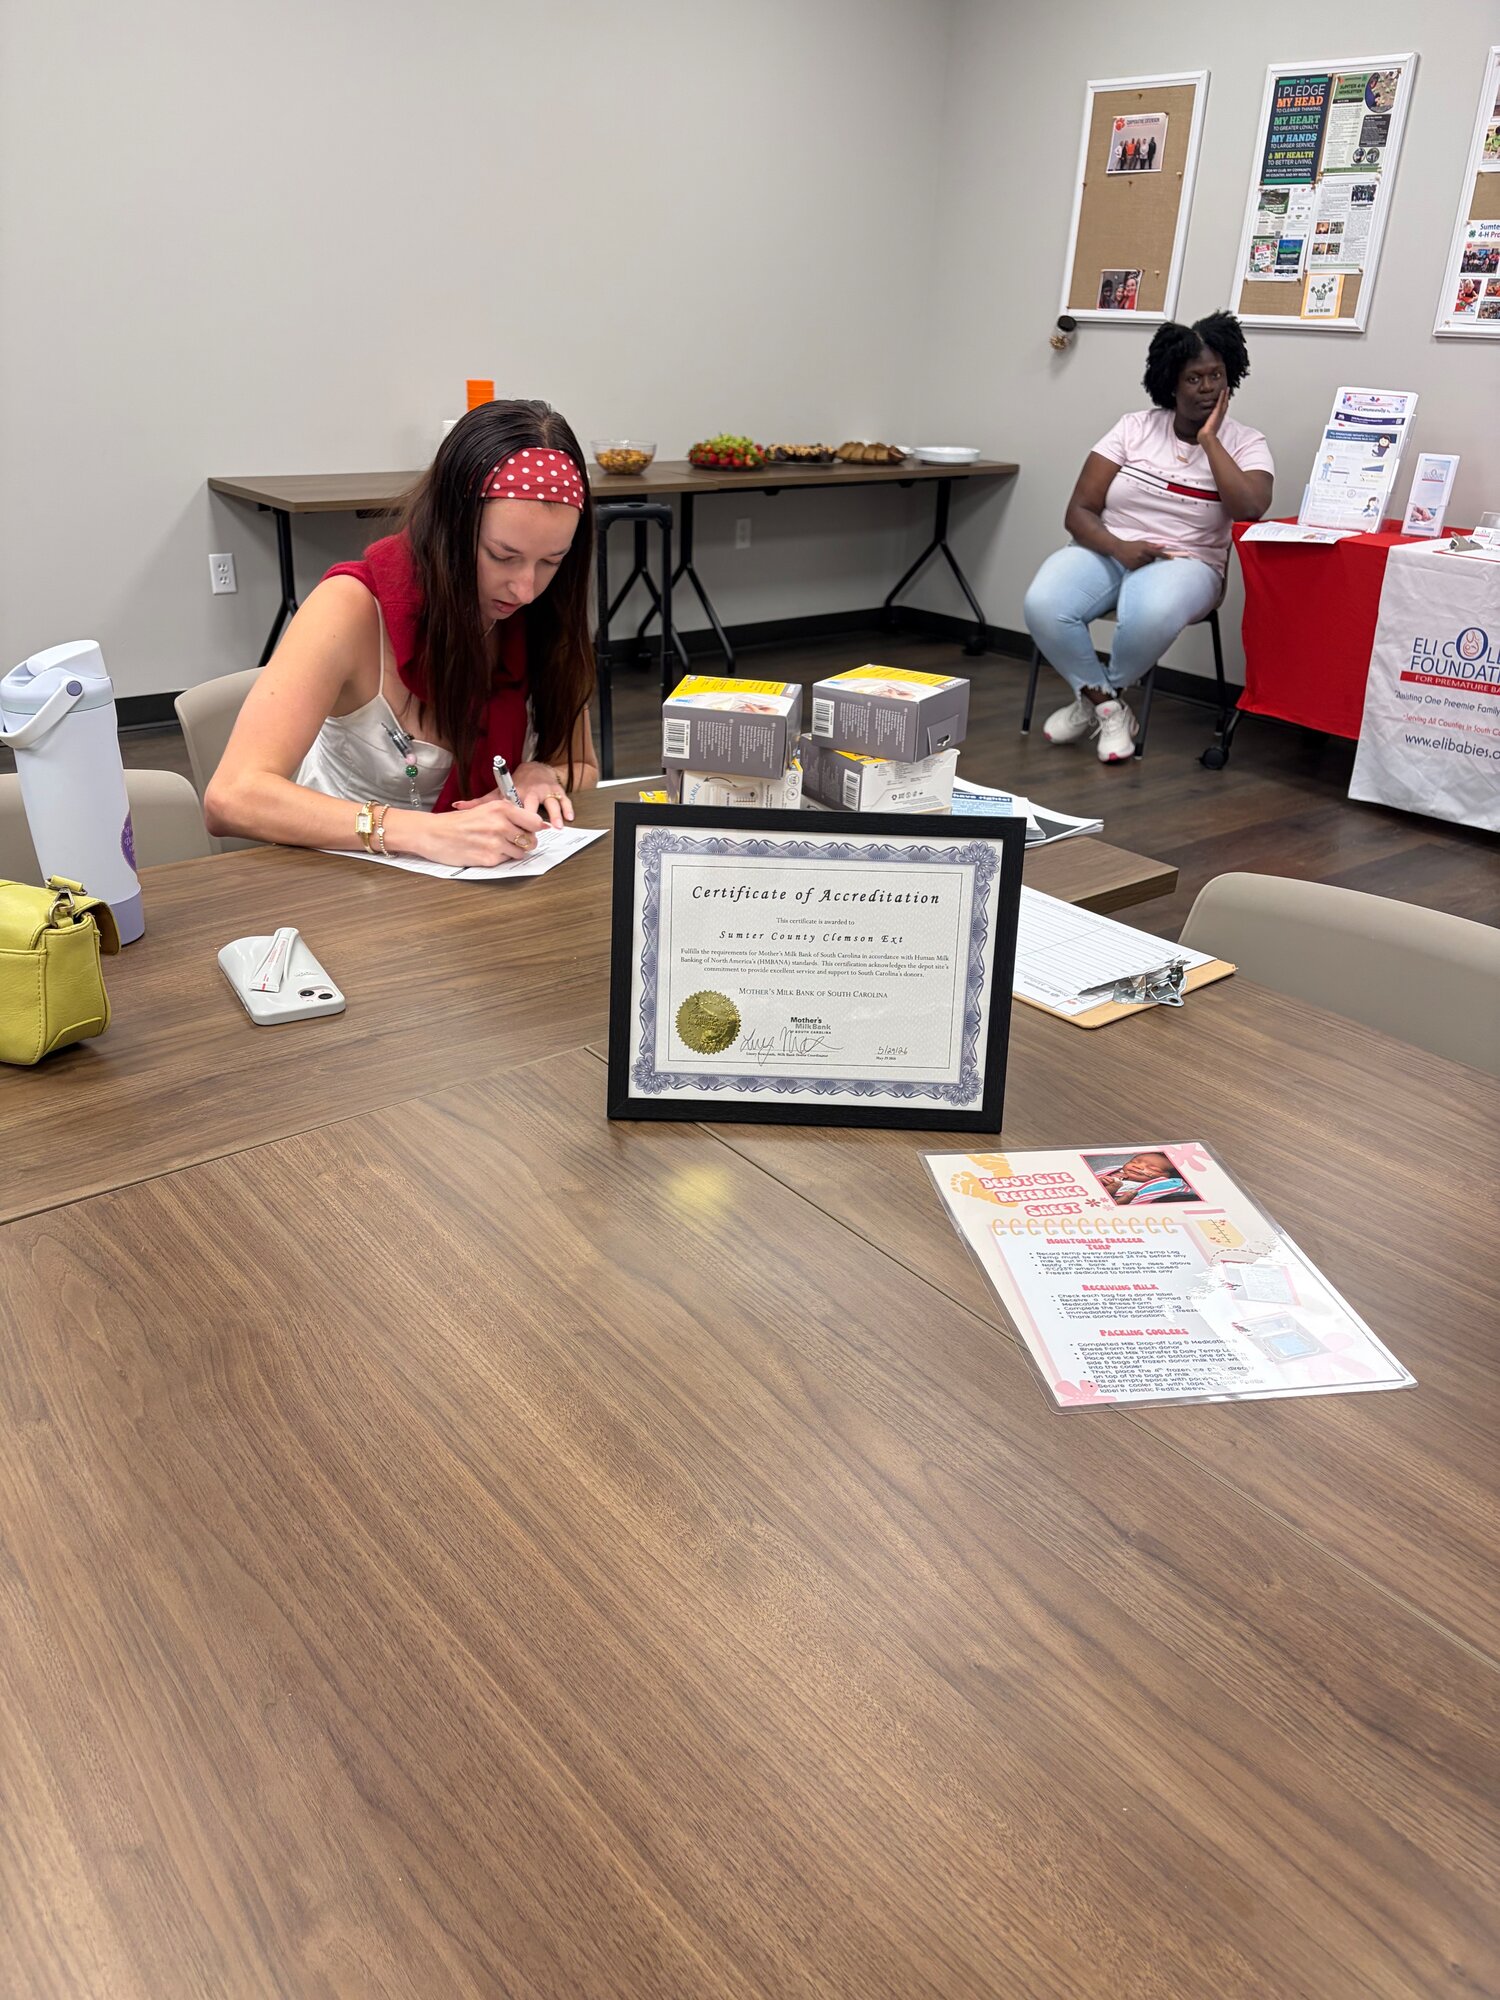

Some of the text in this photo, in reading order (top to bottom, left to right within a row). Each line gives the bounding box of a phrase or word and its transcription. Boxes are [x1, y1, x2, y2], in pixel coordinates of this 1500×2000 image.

[1283, 84, 1326, 96] PLEDGE
[1276, 96, 1324, 108] MY HEAD
[1274, 115, 1320, 125] MY HEART
[1271, 133, 1318, 142] MY HANDS
[1286, 150, 1314, 158] HEALTH
[1412, 637, 1438, 656] ELI
[1415, 675, 1432, 684] FOR
[1436, 678, 1488, 692] PREMATURE
[1424, 695, 1442, 706] One
[1444, 698, 1475, 711] Preemie
[1474, 725, 1490, 734] South
[692, 886, 940, 904] Certificate of Accreditation
[719, 930, 903, 944] Sumter County Clemson Ext
[711, 949, 747, 957] requirements
[738, 987, 774, 995] MOTHER'S
[979, 1175, 1033, 1189] DEPOT
[994, 1186, 1088, 1203] REFERENCE
[1024, 1202, 1082, 1217] SHEET
